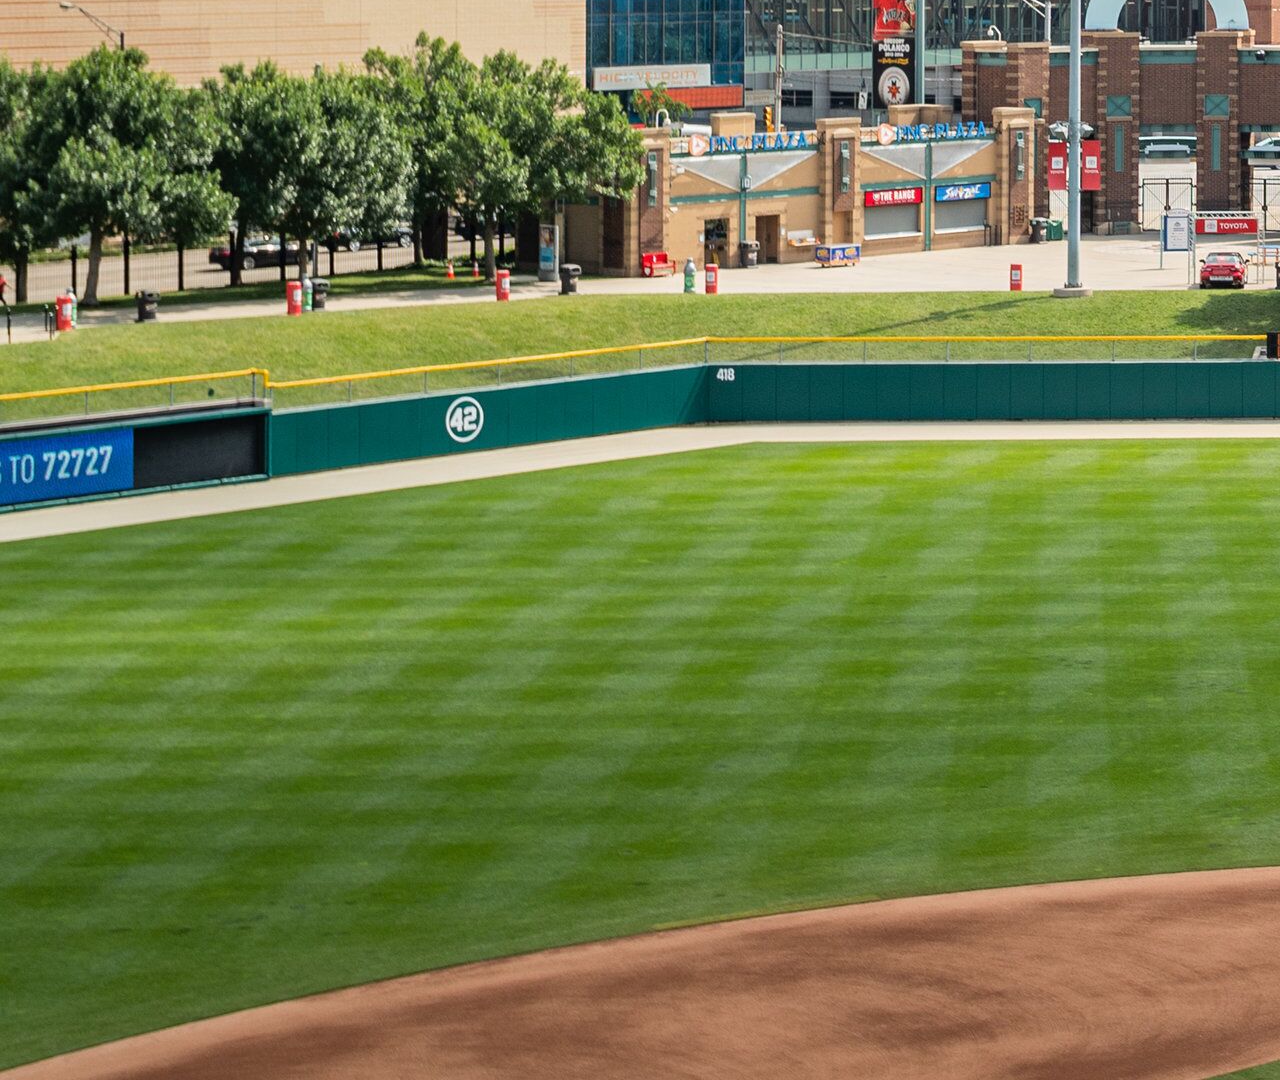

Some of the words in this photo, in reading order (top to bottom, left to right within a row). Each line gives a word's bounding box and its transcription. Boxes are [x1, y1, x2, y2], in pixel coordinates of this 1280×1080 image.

[878, 43, 911, 53] POLANCO
[897, 123, 929, 143] PNC
[935, 121, 987, 139] PLAZA
[709, 134, 745, 154] PNC
[751, 130, 809, 152] PLAZA
[880, 191, 893, 201] THE
[894, 189, 915, 201] RANGE
[1219, 222, 1249, 230] TOYOTA
[716, 368, 735, 381] 418
[450, 405, 478, 432] 42
[9, 453, 35, 484] TO
[42, 445, 113, 481] 72727
